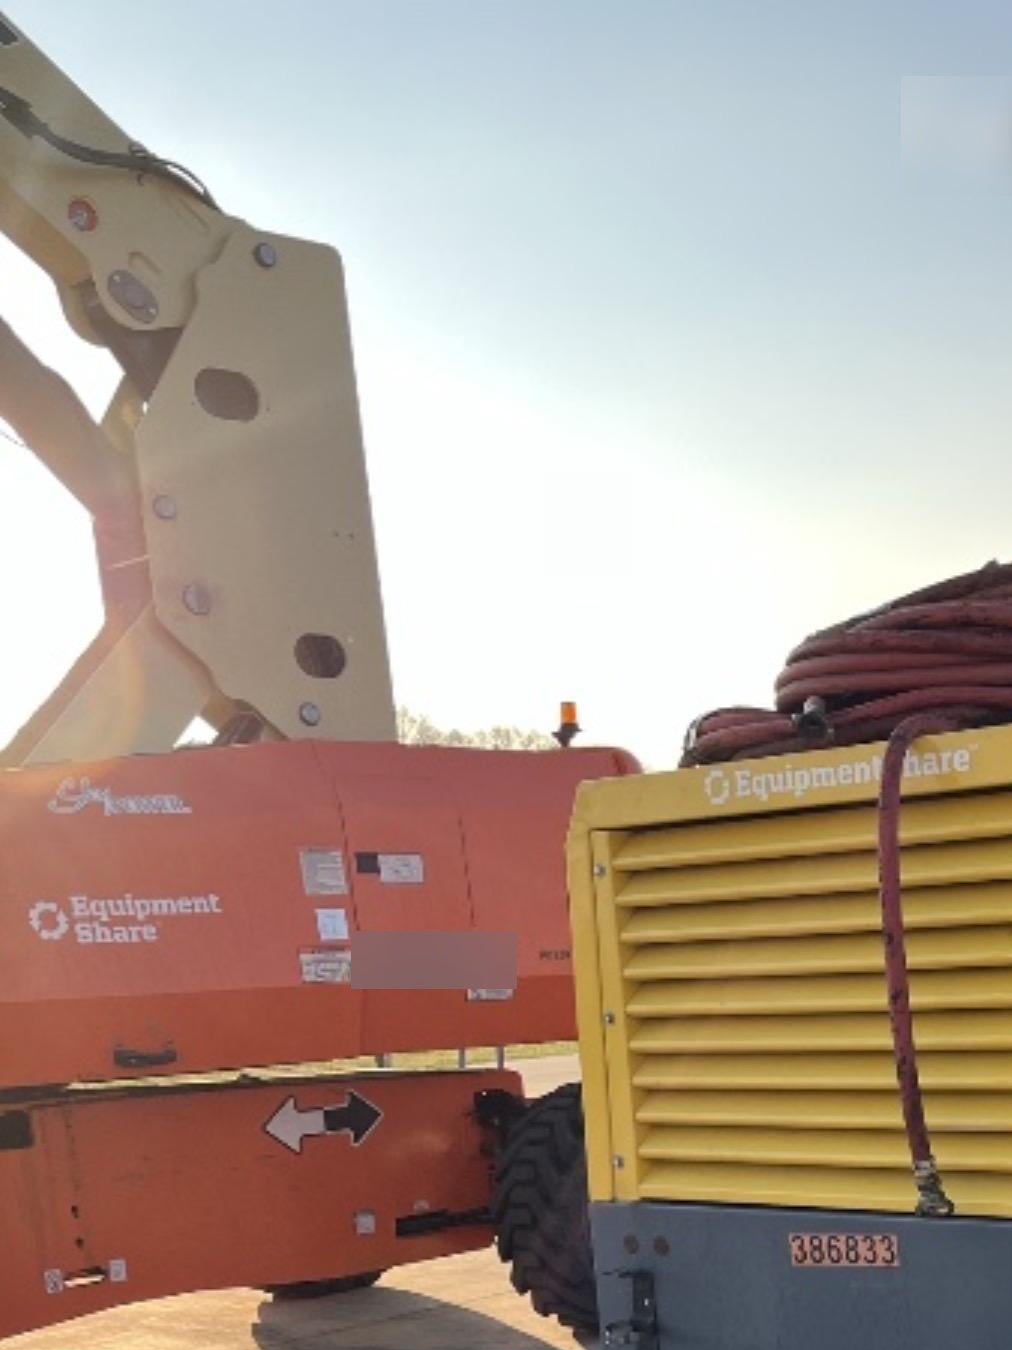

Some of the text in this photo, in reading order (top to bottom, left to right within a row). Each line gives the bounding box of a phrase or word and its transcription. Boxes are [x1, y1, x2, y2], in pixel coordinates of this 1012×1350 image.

[69, 893, 222, 922] Equipment
[74, 922, 158, 944] Share
[791, 1234, 896, 1265] 386833
